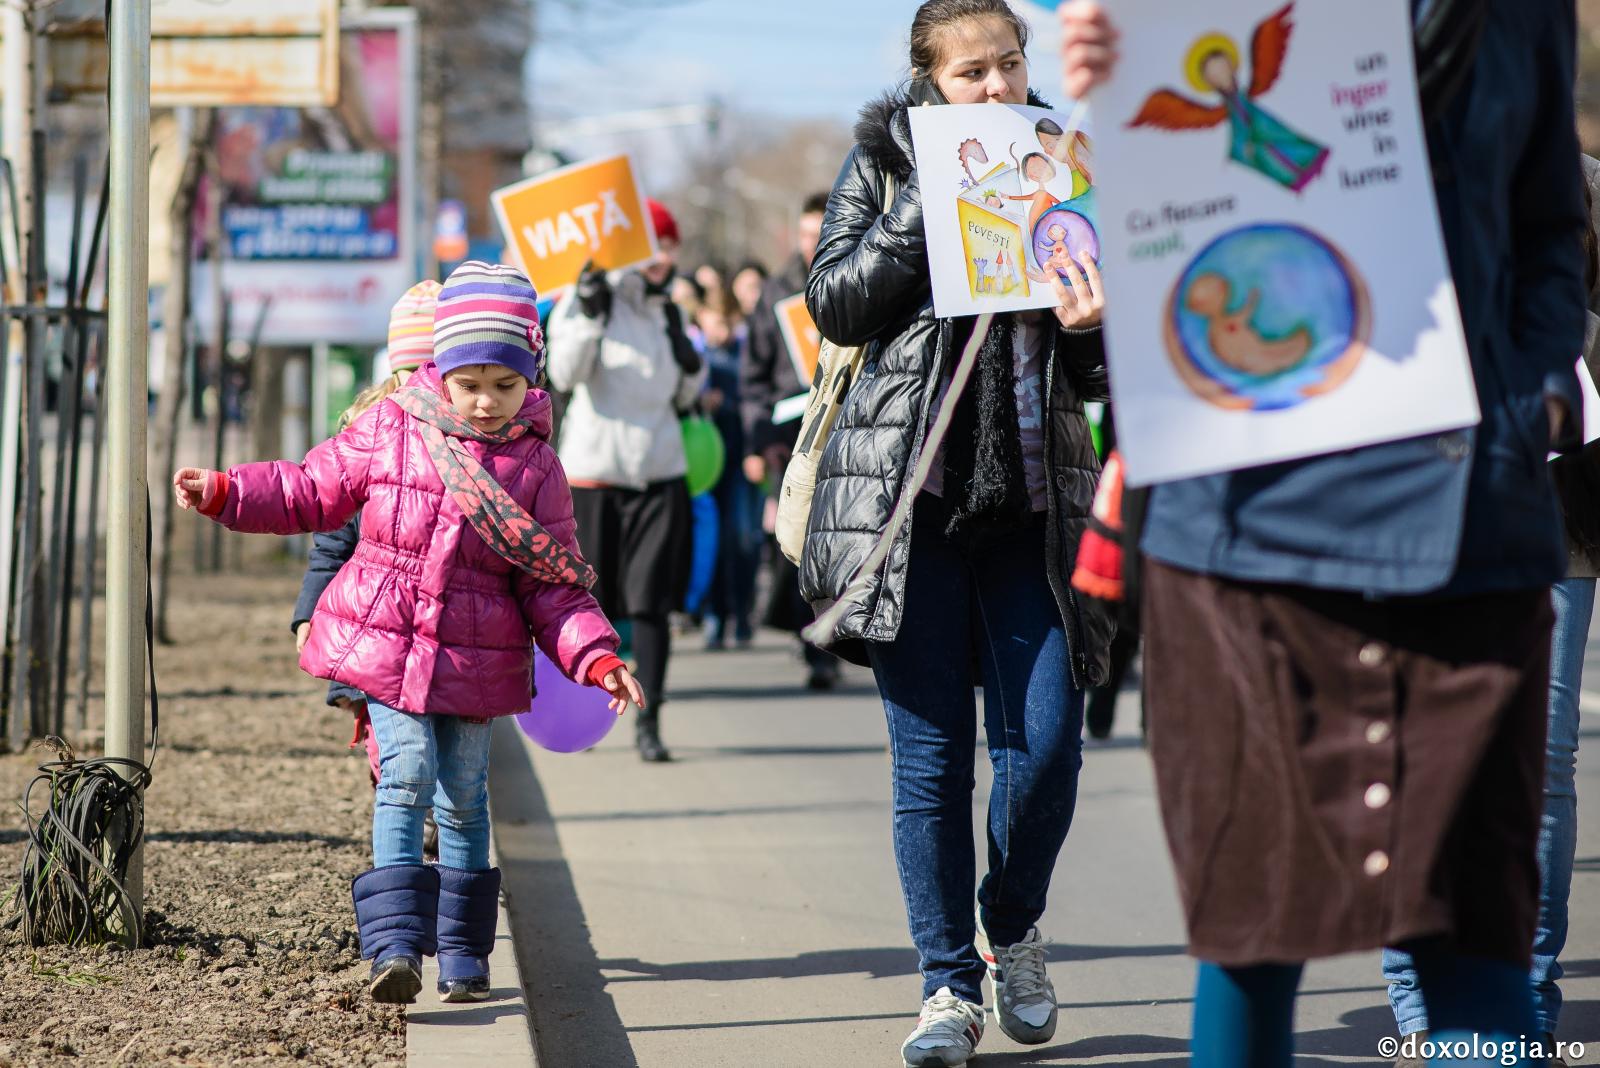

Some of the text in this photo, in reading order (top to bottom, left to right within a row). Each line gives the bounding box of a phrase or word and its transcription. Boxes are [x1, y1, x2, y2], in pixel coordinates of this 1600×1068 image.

[1355, 54, 1387, 73] un
[1344, 109, 1391, 131] vine
[1340, 165, 1400, 188] lume
